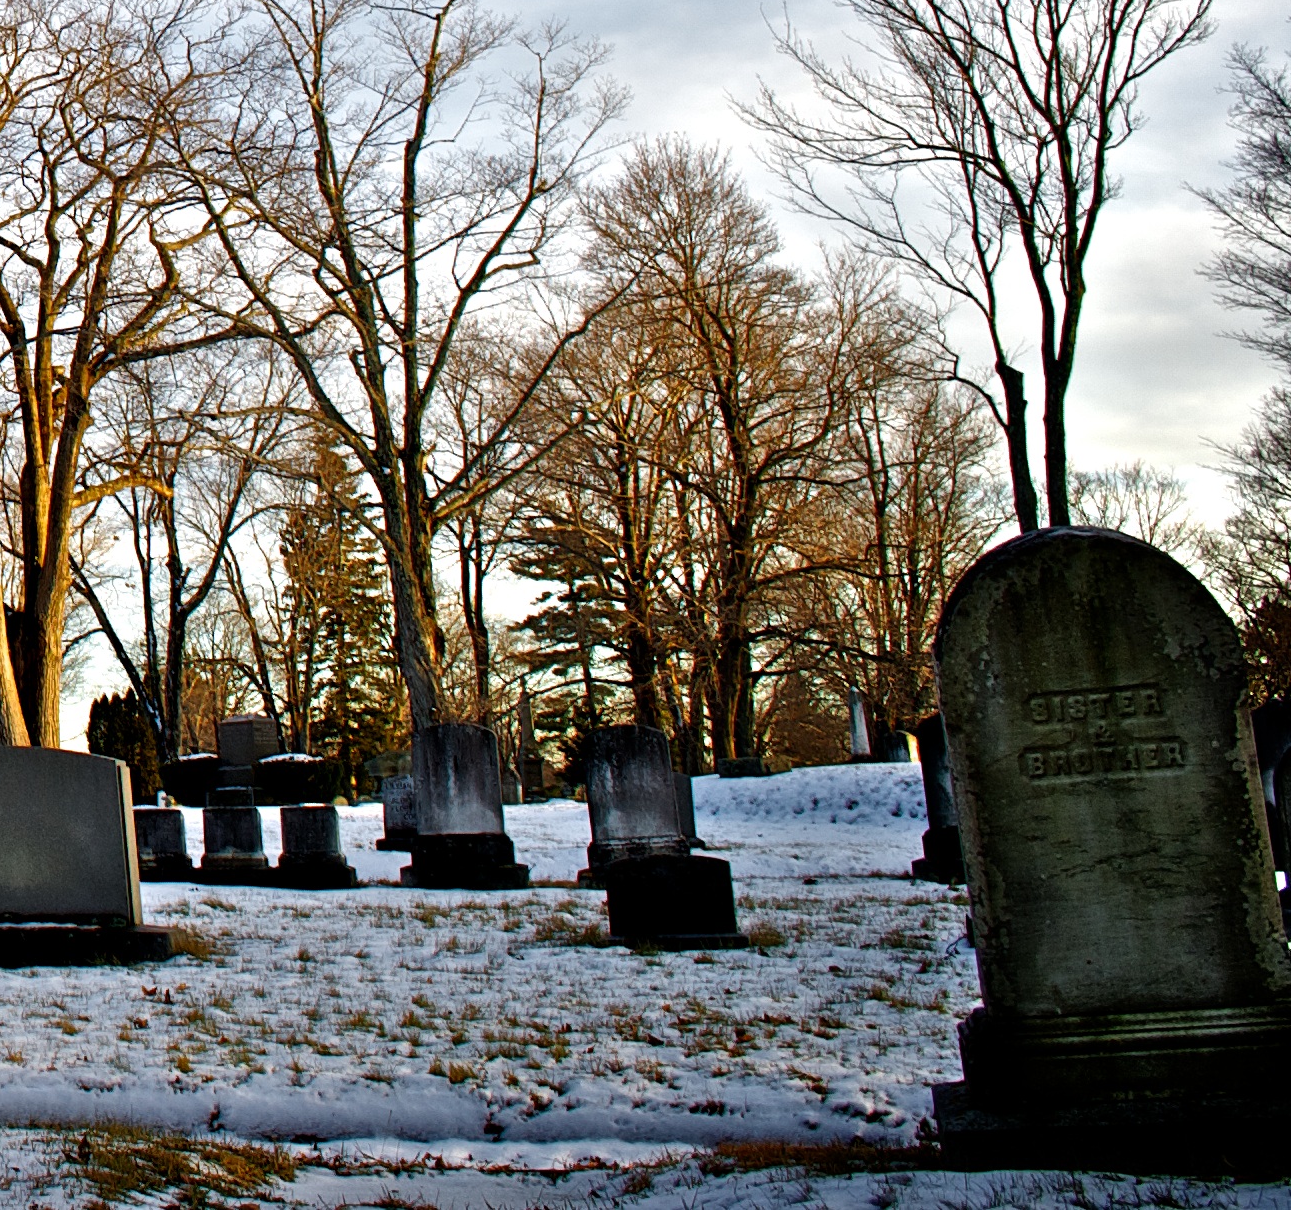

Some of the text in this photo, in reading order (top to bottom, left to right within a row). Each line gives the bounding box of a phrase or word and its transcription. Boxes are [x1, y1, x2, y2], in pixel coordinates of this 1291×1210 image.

[1030, 689, 1162, 722] SISTER
[1089, 722, 1112, 740] &
[1026, 743, 1186, 776] BROTHER
